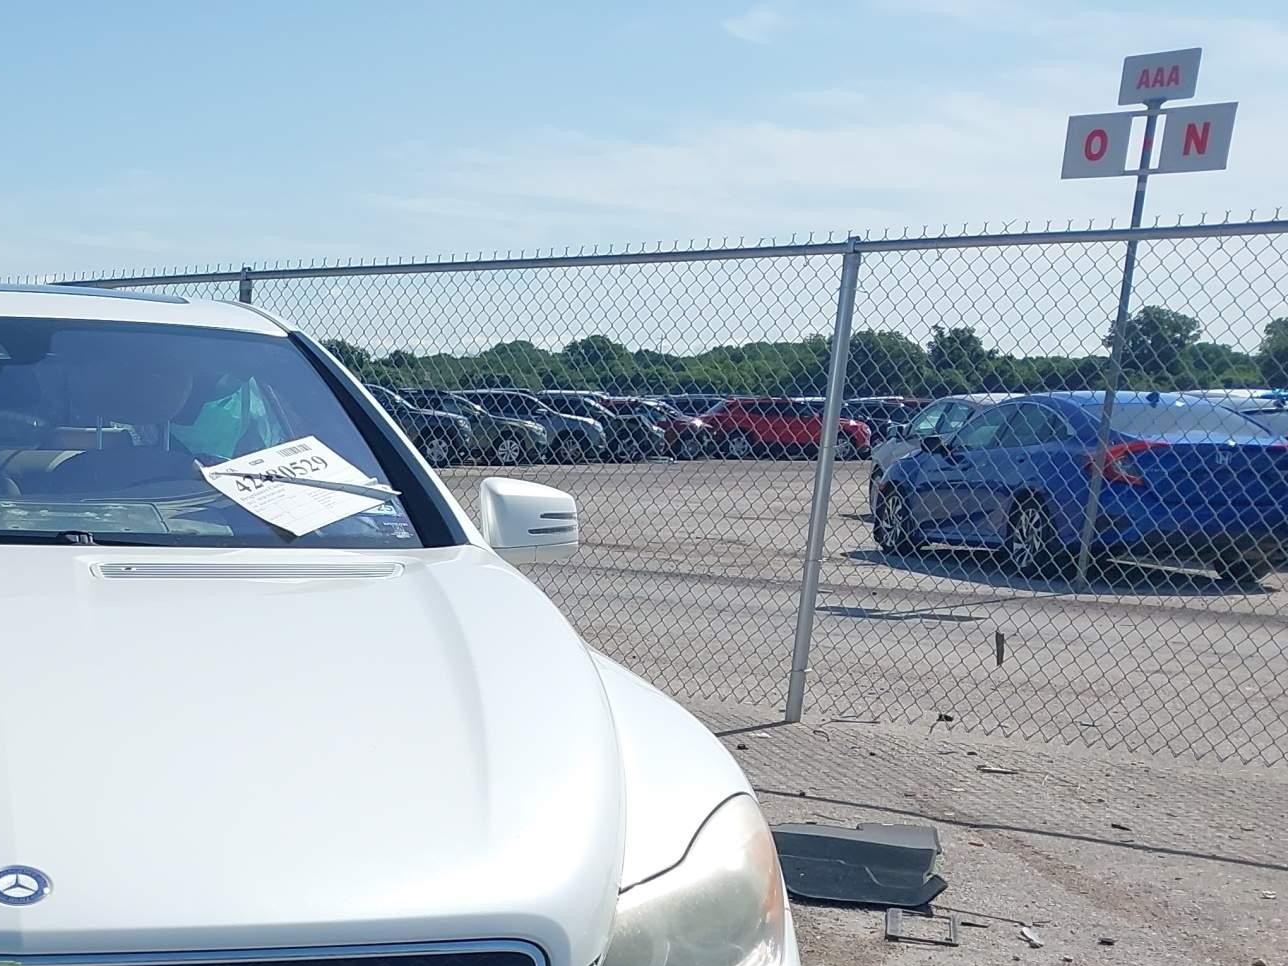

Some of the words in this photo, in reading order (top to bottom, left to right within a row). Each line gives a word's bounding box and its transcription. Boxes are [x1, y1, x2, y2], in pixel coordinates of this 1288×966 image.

[1136, 65, 1180, 90] AAA
[1182, 122, 1210, 156] N
[235, 455, 329, 493] 4280529
